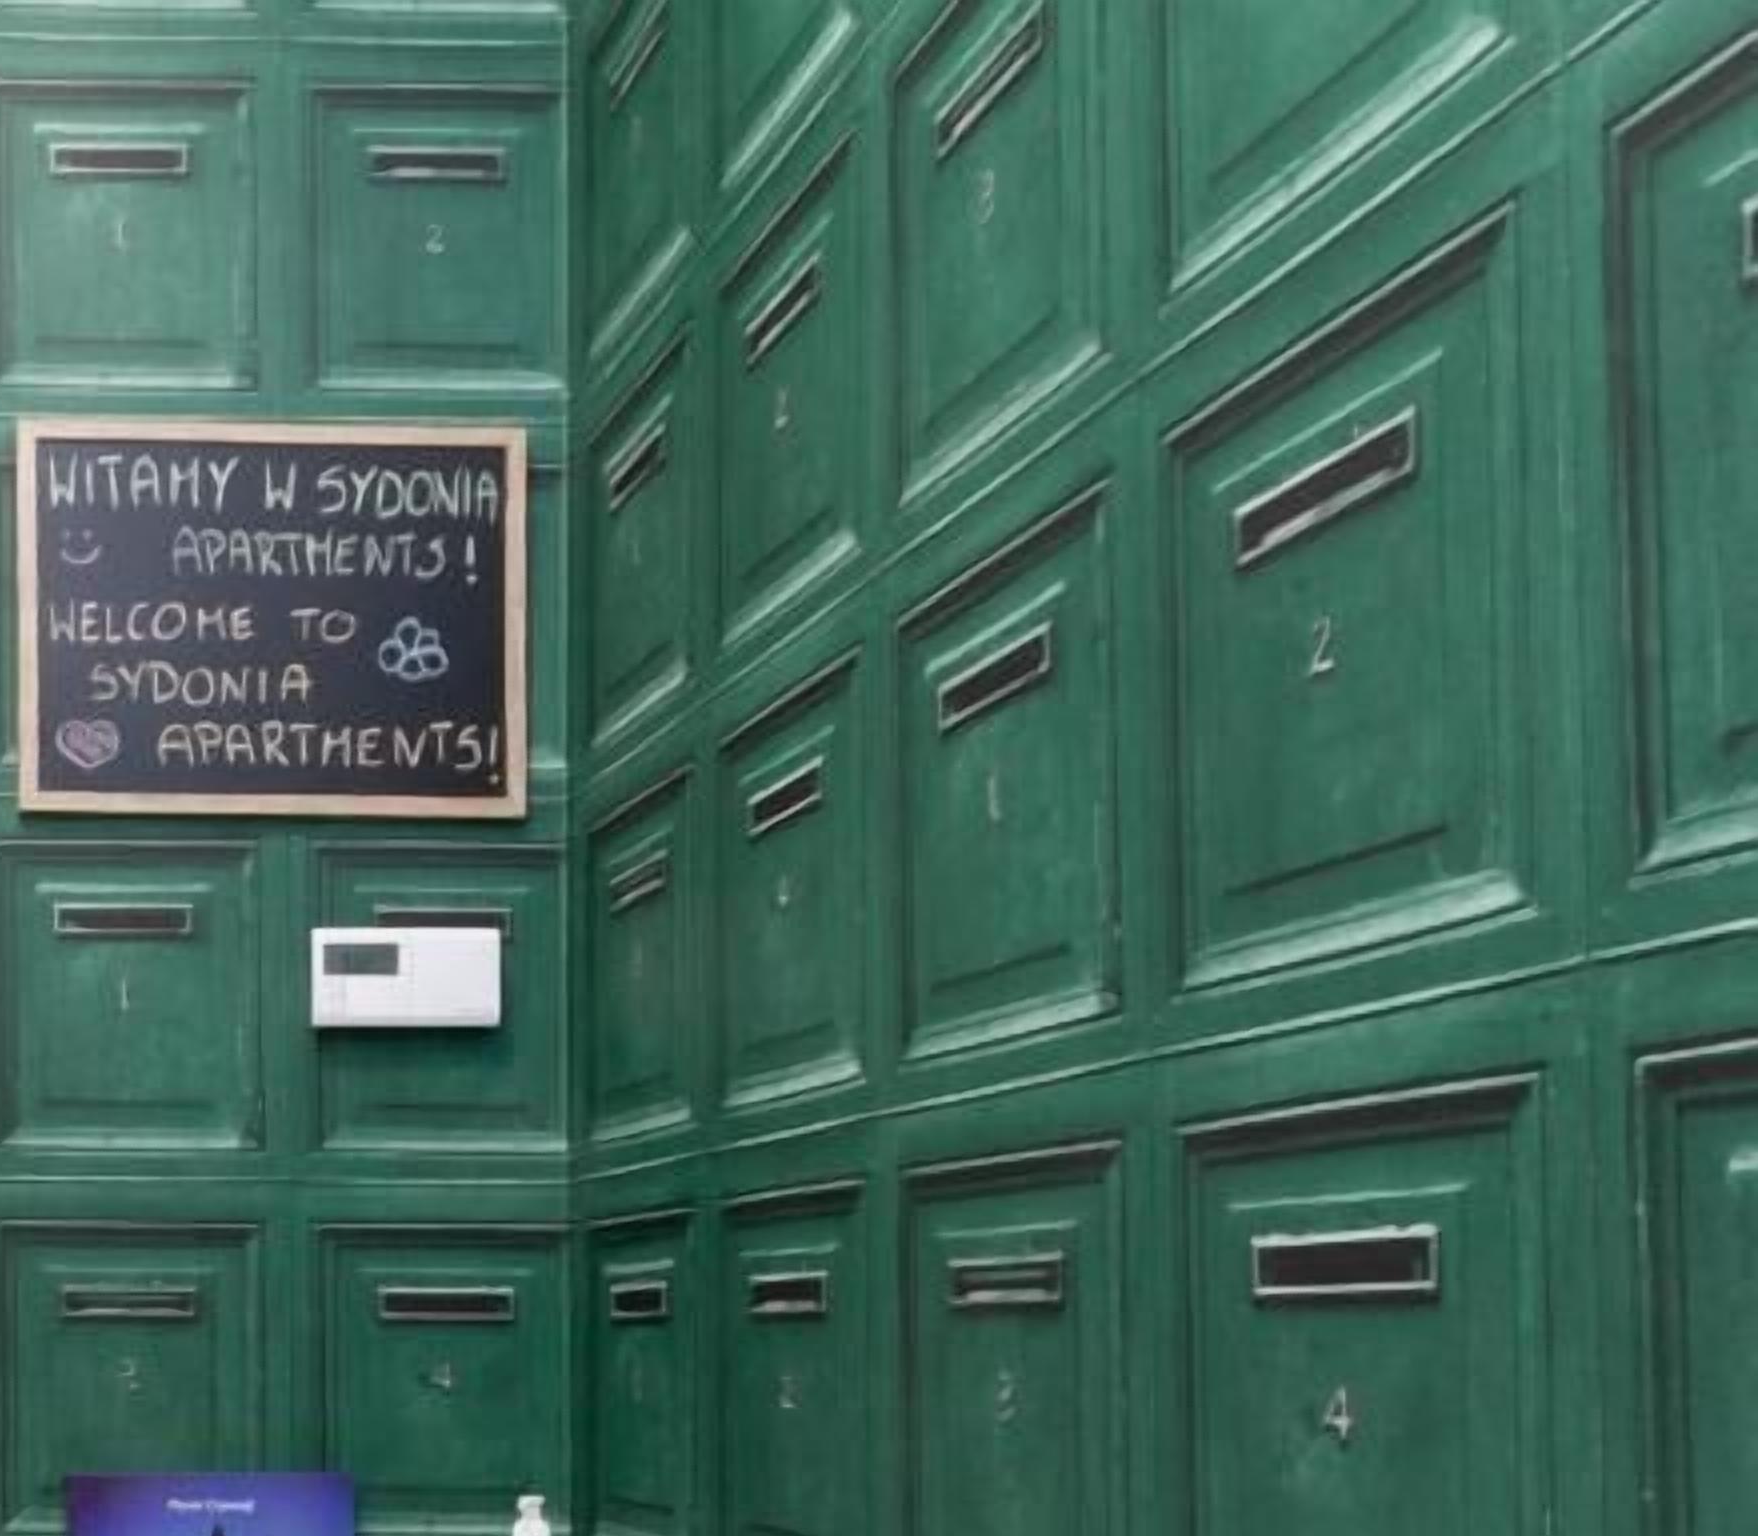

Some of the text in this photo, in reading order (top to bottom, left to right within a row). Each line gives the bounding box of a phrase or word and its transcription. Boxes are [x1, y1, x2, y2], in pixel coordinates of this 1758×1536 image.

[425, 224, 446, 254] 2
[49, 454, 500, 527] WITAMY W SYDONIA
[49, 601, 357, 644] WELCOME TO
[1307, 615, 1336, 677] 2
[89, 661, 317, 707] SYDONIA
[156, 721, 501, 787] APARTMENTS!
[1322, 1386, 1355, 1445] 4
